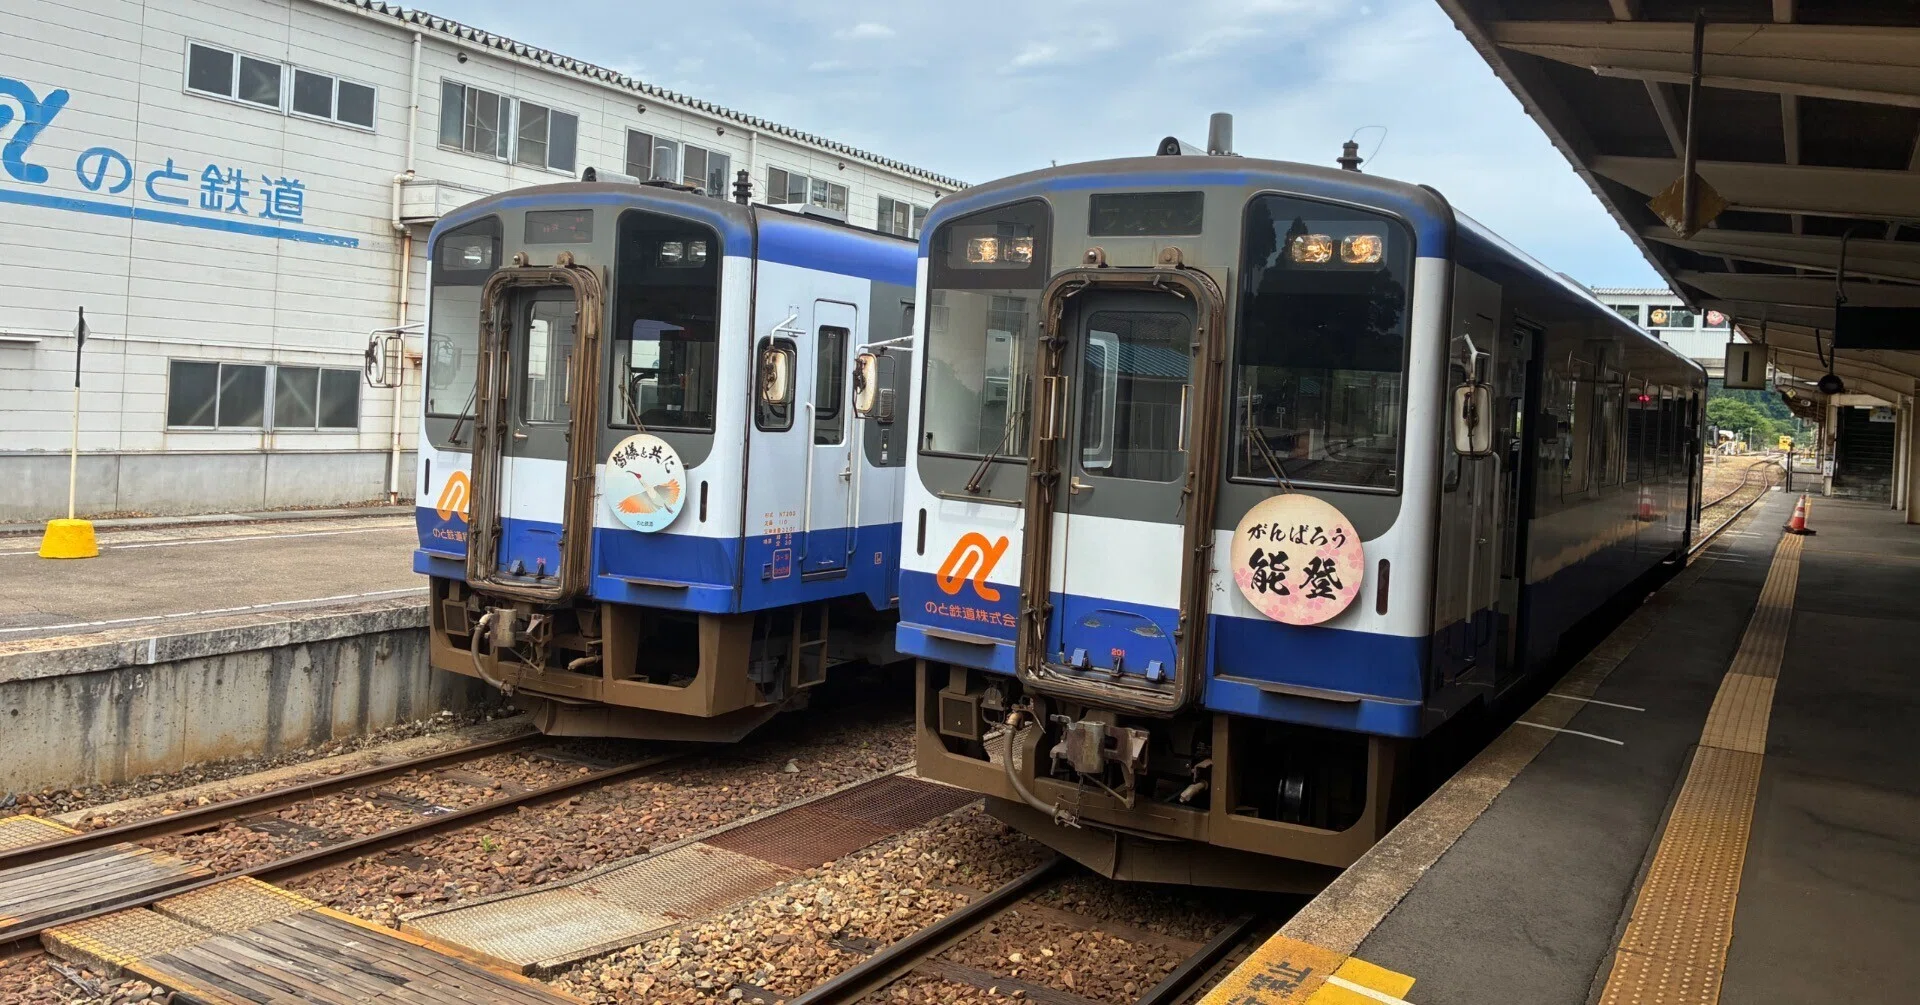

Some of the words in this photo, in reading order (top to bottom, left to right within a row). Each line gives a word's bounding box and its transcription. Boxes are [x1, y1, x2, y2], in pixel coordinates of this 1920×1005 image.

[76, 146, 306, 224] のと鉄道
[1247, 523, 1346, 549] がんばろう
[1249, 548, 1343, 600] 能登
[925, 602, 1019, 627] のと鉄道株式会
[1111, 648, 1125, 656] 201
